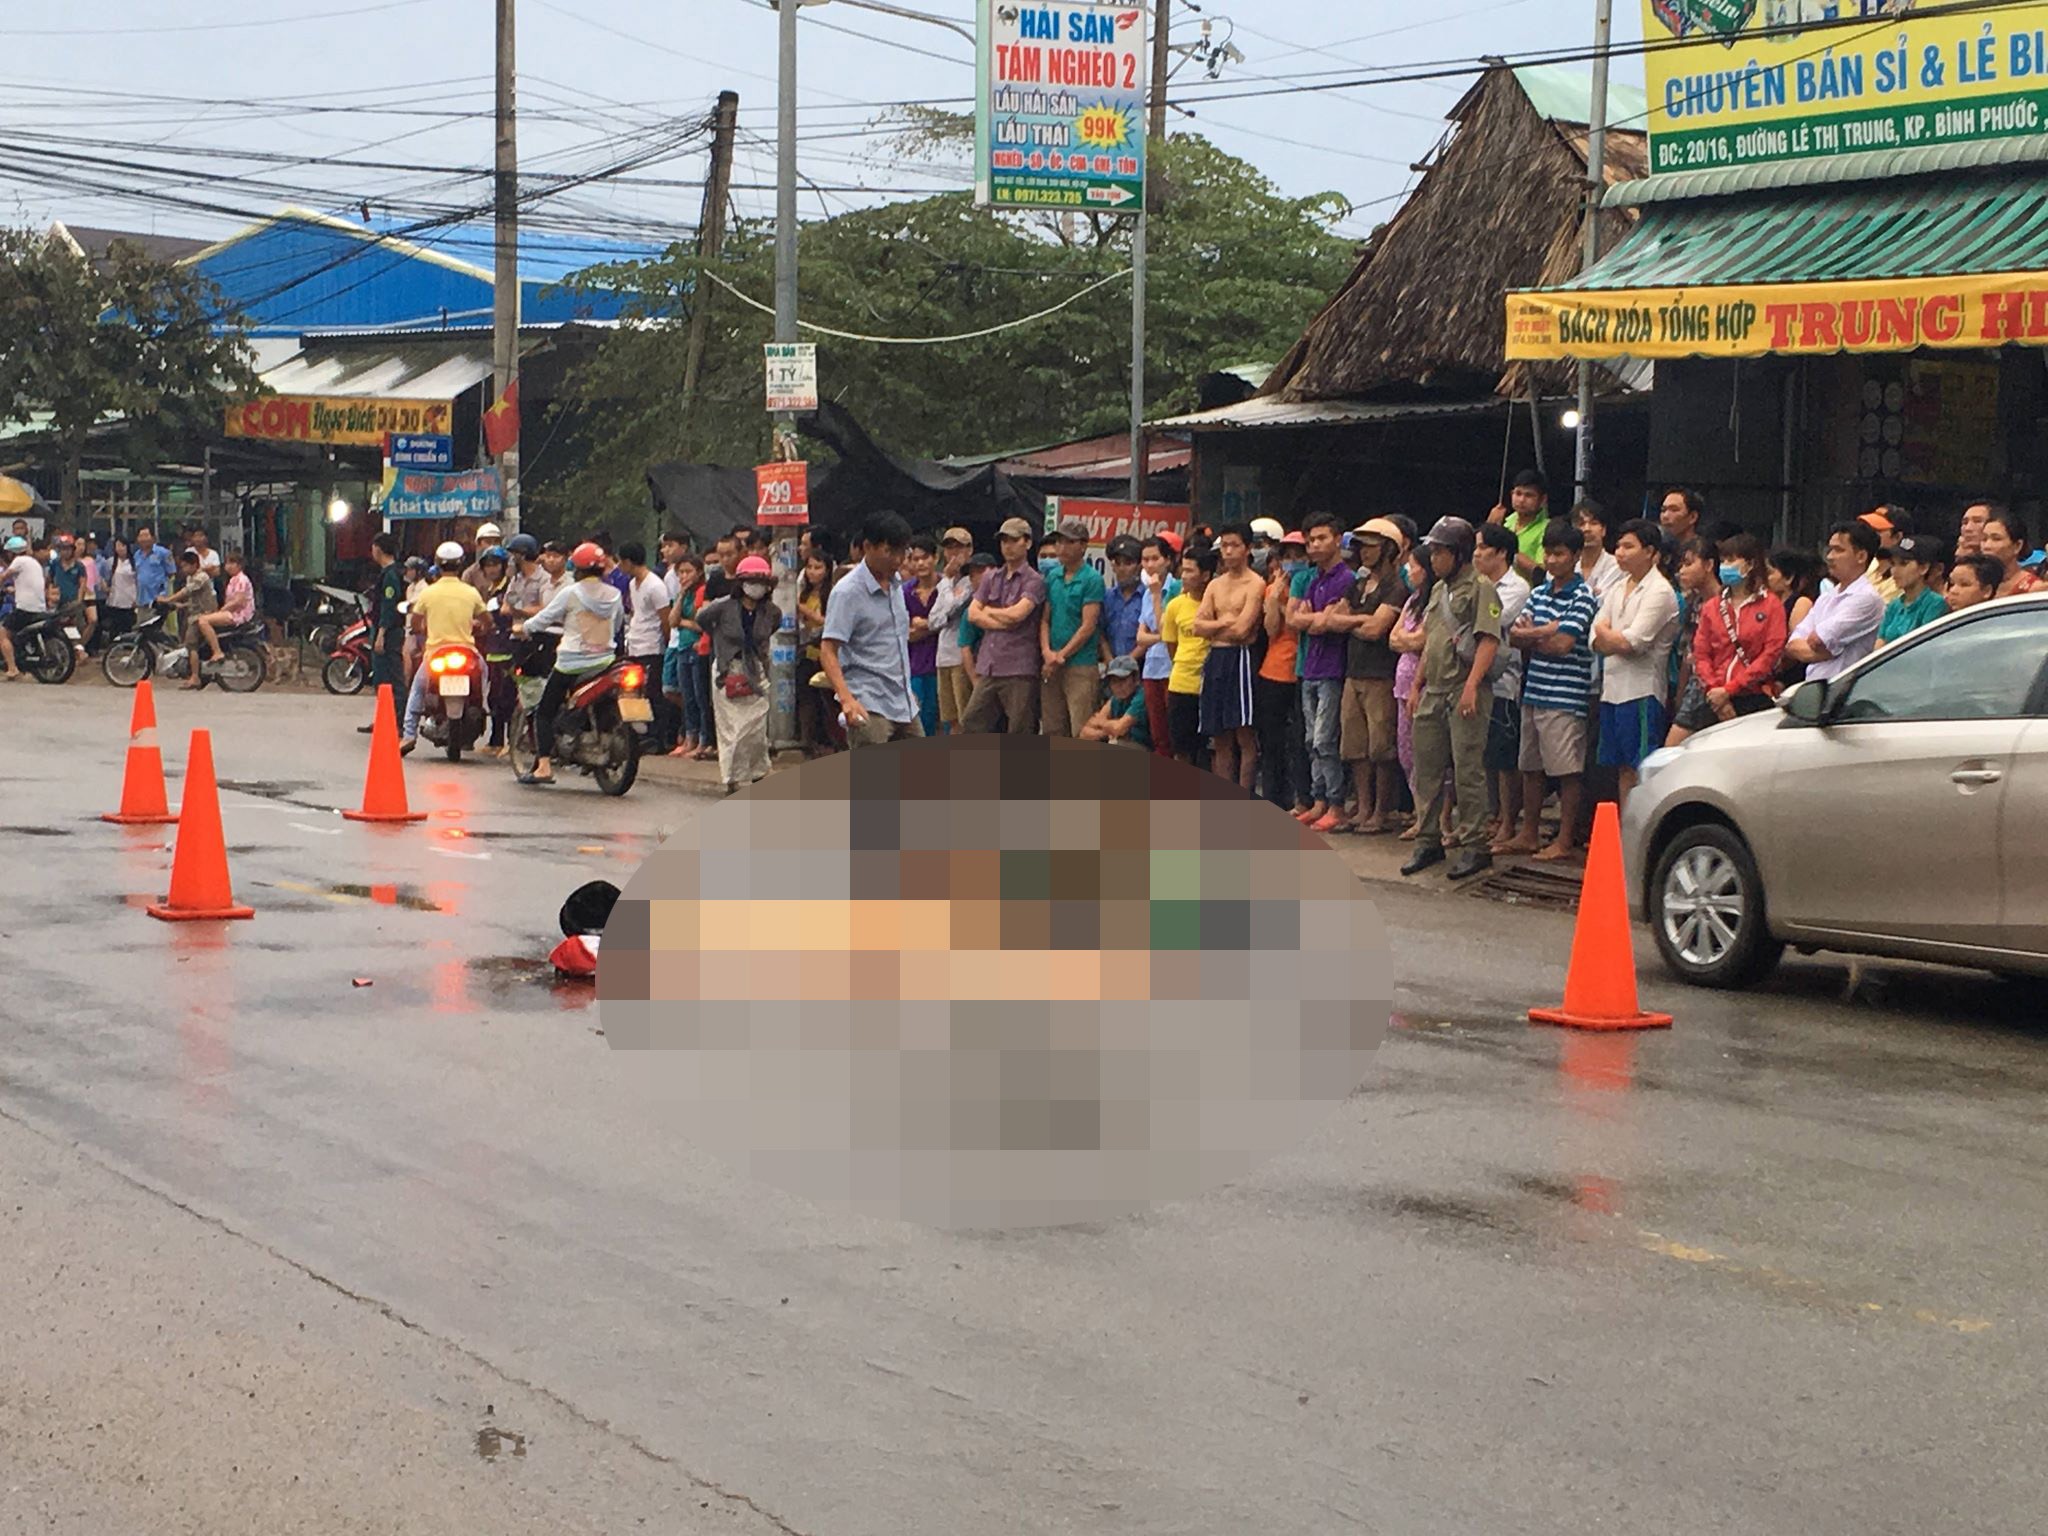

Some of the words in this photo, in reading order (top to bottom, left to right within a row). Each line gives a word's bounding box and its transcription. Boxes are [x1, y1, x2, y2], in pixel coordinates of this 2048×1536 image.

[1020, 3, 1060, 40] HẢI
[1068, 6, 1115, 44] SẢN
[996, 40, 1041, 83] TÁM
[1048, 46, 1116, 88] NGHÈO
[1123, 53, 1136, 89] 2
[1665, 58, 1785, 118] CHUYÊN
[1797, 47, 1863, 102] BÁN
[1875, 34, 1907, 93] SỈ
[1921, 45, 1945, 88] &
[1958, 22, 1997, 83] LẺ
[2009, 30, 2048, 77] BI
[1031, 122, 1070, 147] THÁI
[1084, 116, 1117, 140] 99K
[1659, 142, 1683, 167] ĐC:
[1686, 137, 1733, 163] 20/16,
[1736, 127, 1787, 158] ĐƯỜNG
[1791, 123, 1810, 152] LÊ
[1812, 124, 1839, 153] THỊ
[1843, 118, 1900, 146] TRUNG,
[1904, 115, 1931, 140] KP.
[1935, 106, 1975, 137] BÌNH
[1981, 97, 2038, 132] PHƯỚC
[1559, 301, 1609, 344] BÁCH
[1612, 299, 1652, 343] HÓA
[1658, 291, 1709, 342] TỔNG
[1716, 299, 1756, 349] HỢP
[1765, 294, 1963, 349] TRUNG
[759, 480, 791, 506] 799
